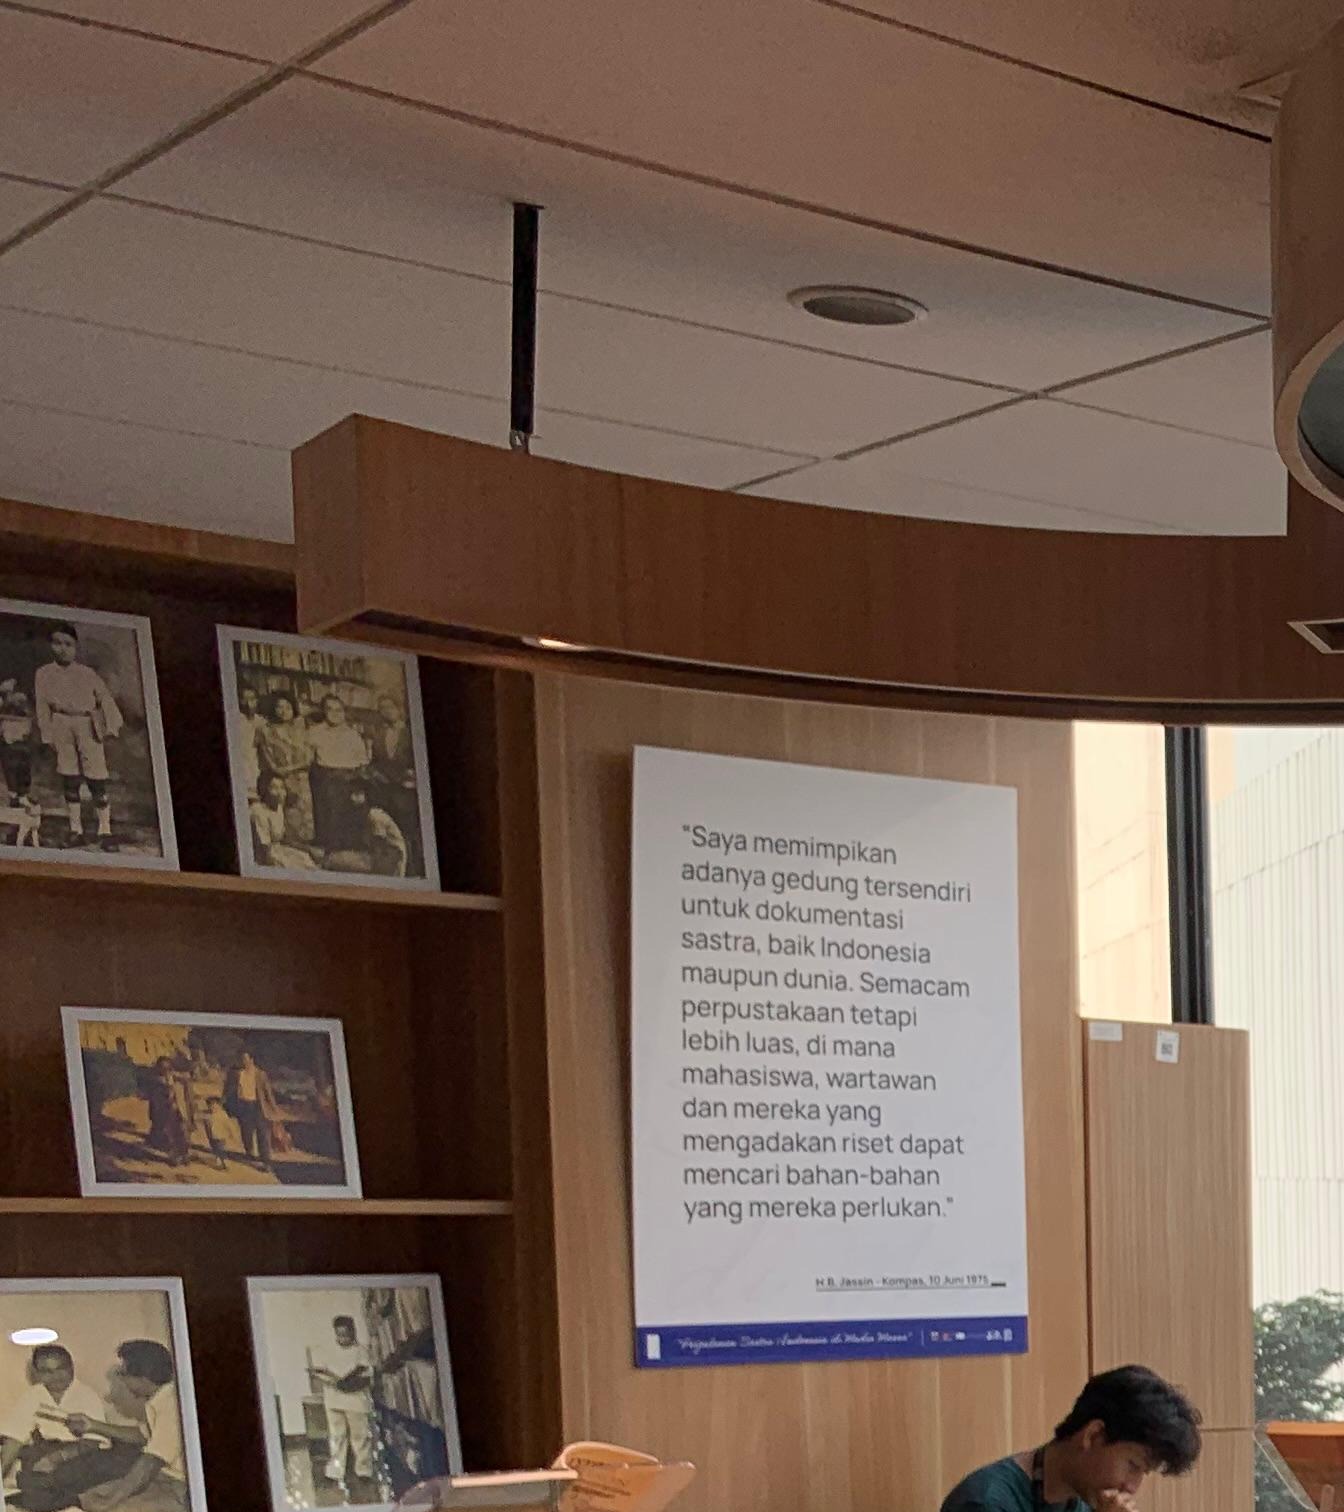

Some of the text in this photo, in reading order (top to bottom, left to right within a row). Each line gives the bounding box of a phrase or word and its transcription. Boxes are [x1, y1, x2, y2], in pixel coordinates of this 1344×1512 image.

[753, 836, 897, 867] memimpikan
[681, 860, 971, 903] adanya gedung tersendiri
[681, 896, 904, 930] untuk dokumentasi
[681, 930, 931, 964] sastra, baik Indonesia
[681, 965, 970, 998] maupun dunia. Semacam
[681, 999, 917, 1033] perpustakaan tetapi
[682, 1028, 895, 1059] lebih luas, di mana
[682, 1063, 937, 1091] mahasiswa, wartawan
[682, 1096, 882, 1128] dan mereka yang
[683, 1131, 965, 1160] mengadakan riset dapat
[683, 1164, 940, 1186] mencari bahan-bahan
[683, 1200, 743, 1225] yang
[749, 1197, 836, 1218] mereka
